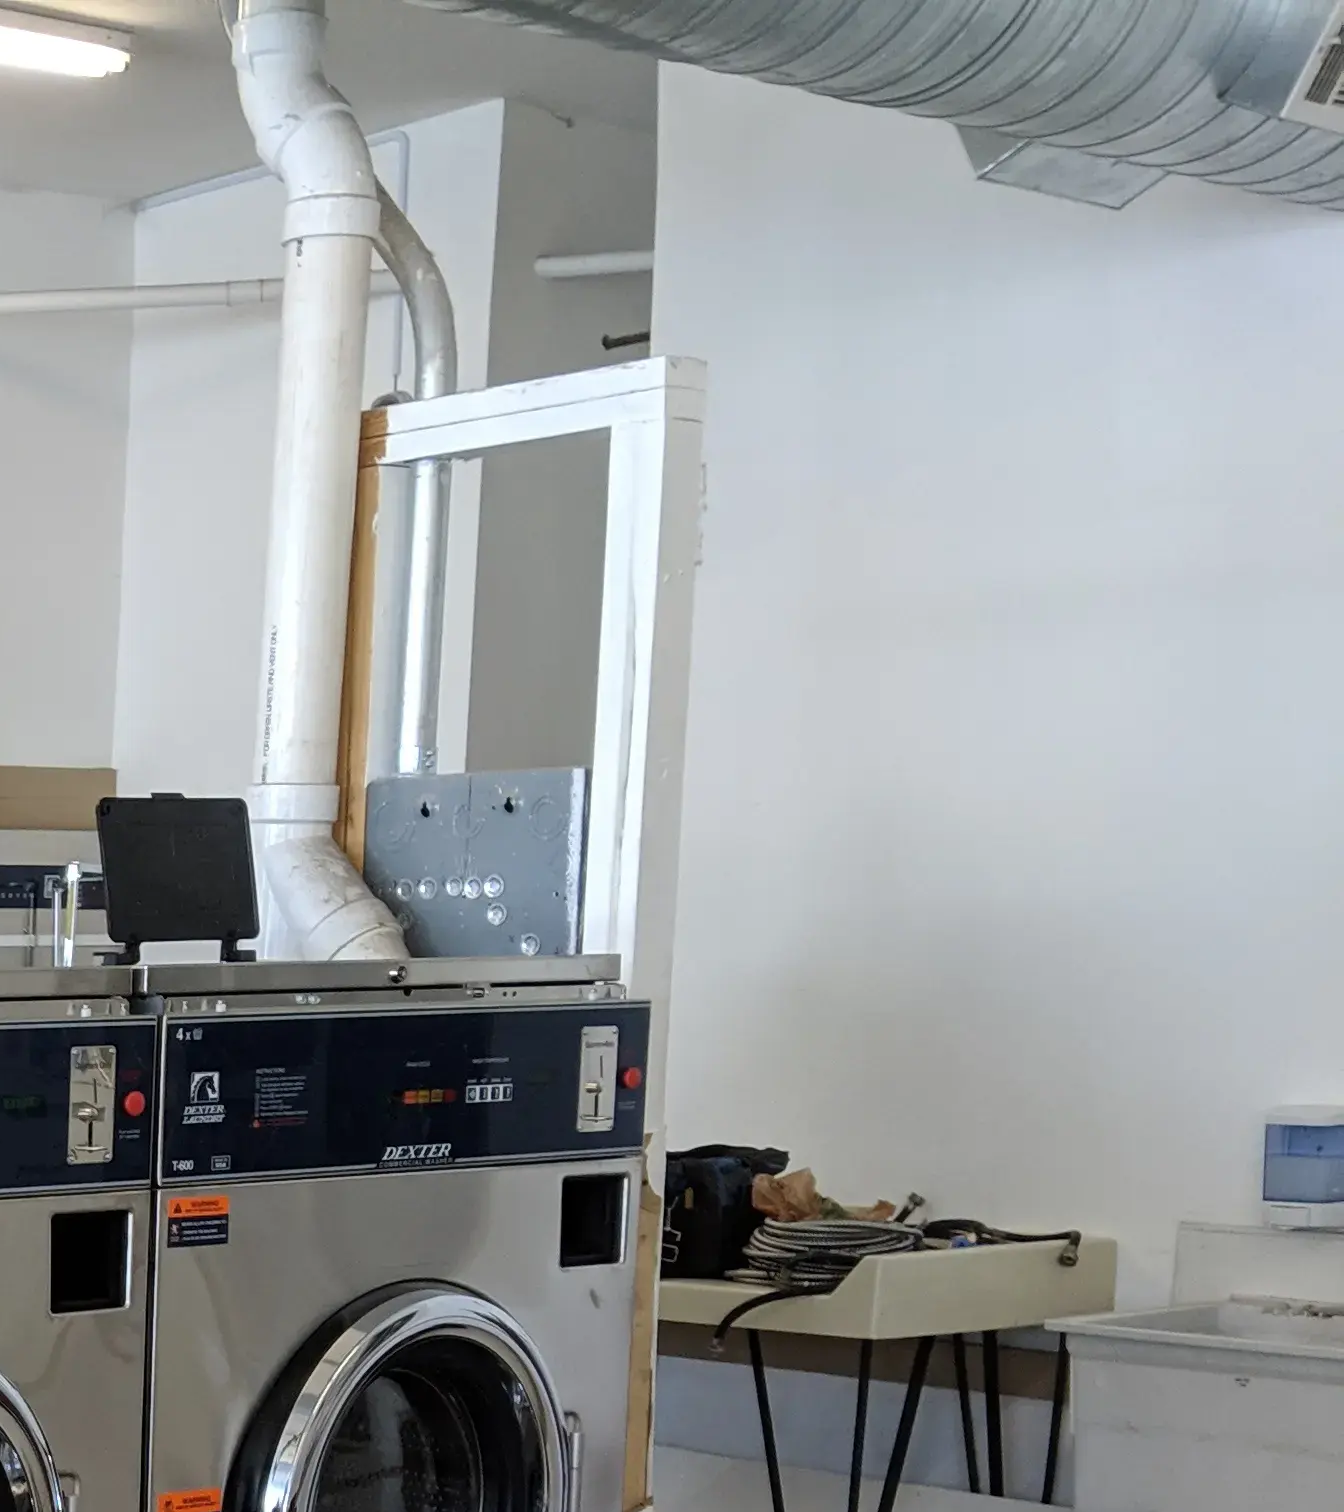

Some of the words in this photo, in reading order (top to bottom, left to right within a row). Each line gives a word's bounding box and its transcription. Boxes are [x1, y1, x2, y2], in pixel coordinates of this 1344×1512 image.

[184, 1105, 225, 1115] DEXTER
[381, 1143, 452, 1161] DEXTER
[172, 1160, 194, 1171] T-600
